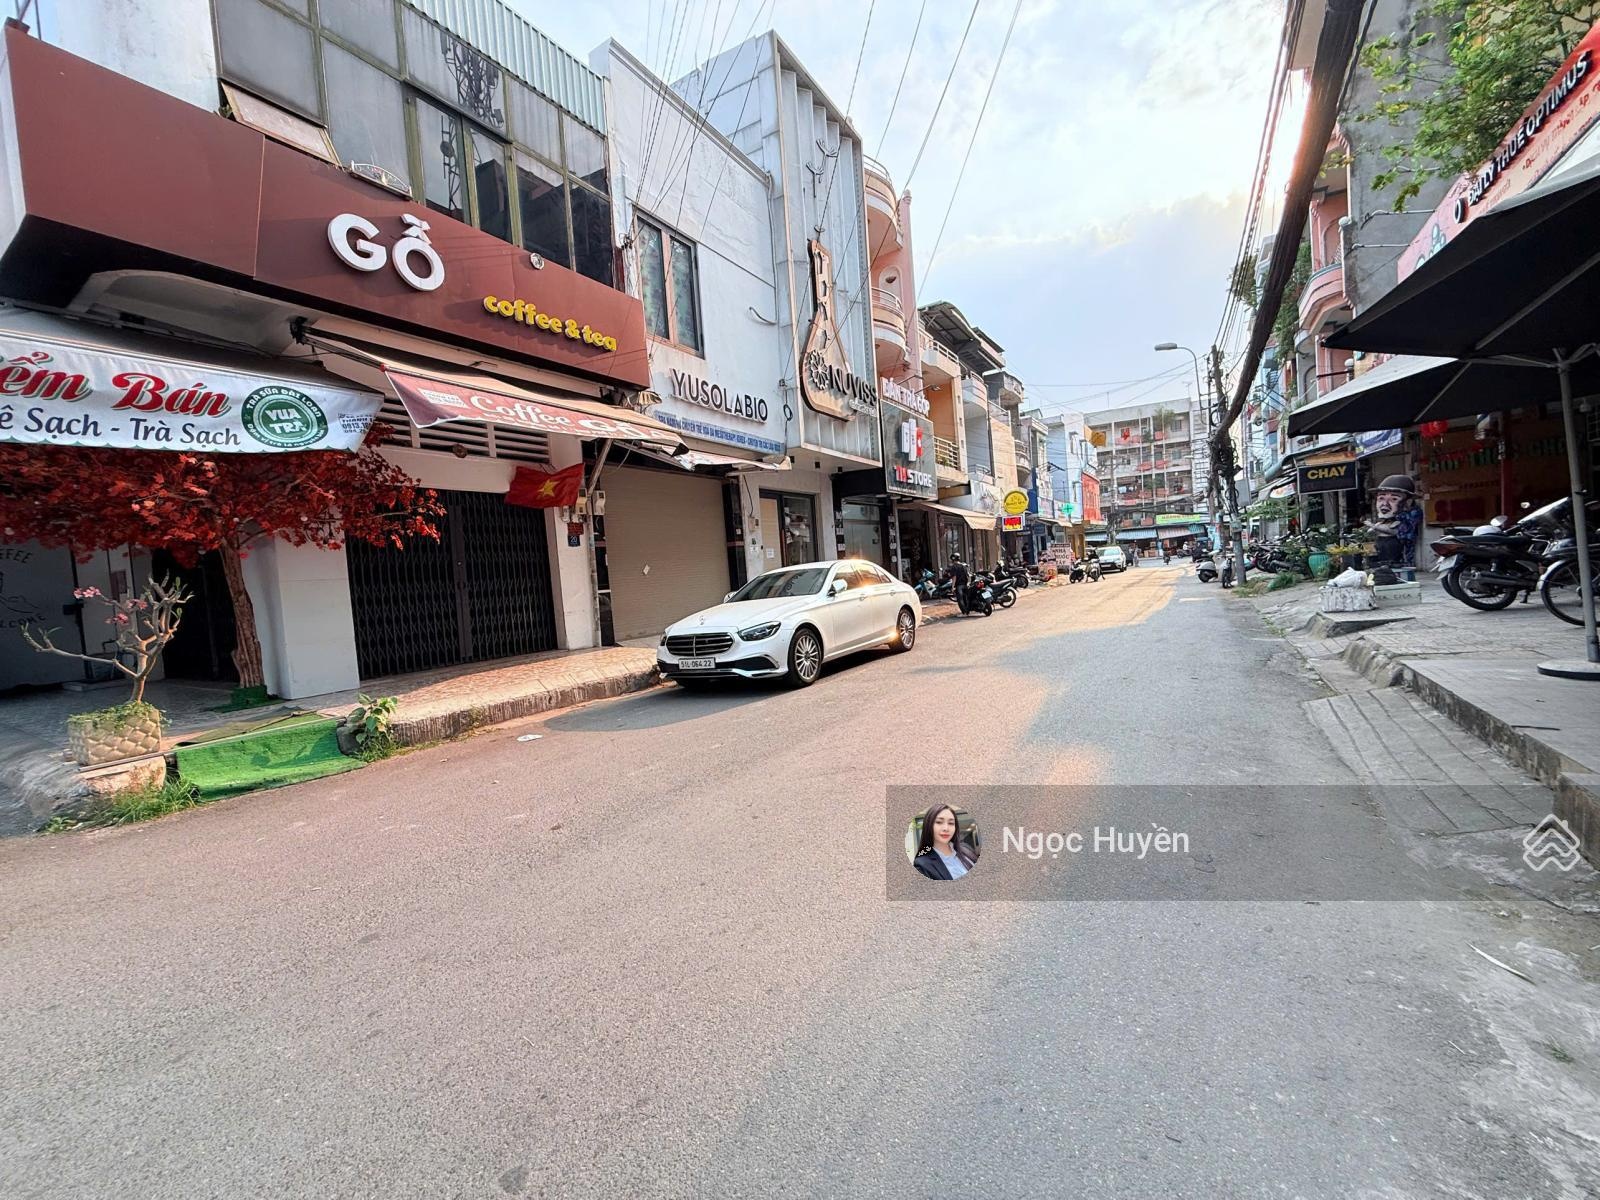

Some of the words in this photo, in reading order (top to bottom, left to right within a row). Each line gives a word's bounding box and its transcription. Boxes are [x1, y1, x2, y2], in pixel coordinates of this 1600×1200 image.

[1526, 49, 1590, 137] OPTIMUS
[327, 212, 446, 292] GỖ
[111, 372, 232, 417] Bán
[246, 394, 261, 409] TRÀ
[265, 408, 301, 421] VUA
[470, 395, 571, 425] Coffee
[670, 368, 768, 422] YUSOLABIO
[24, 407, 102, 439] Sạch
[130, 417, 172, 442] Trà
[180, 423, 241, 448] Sạch
